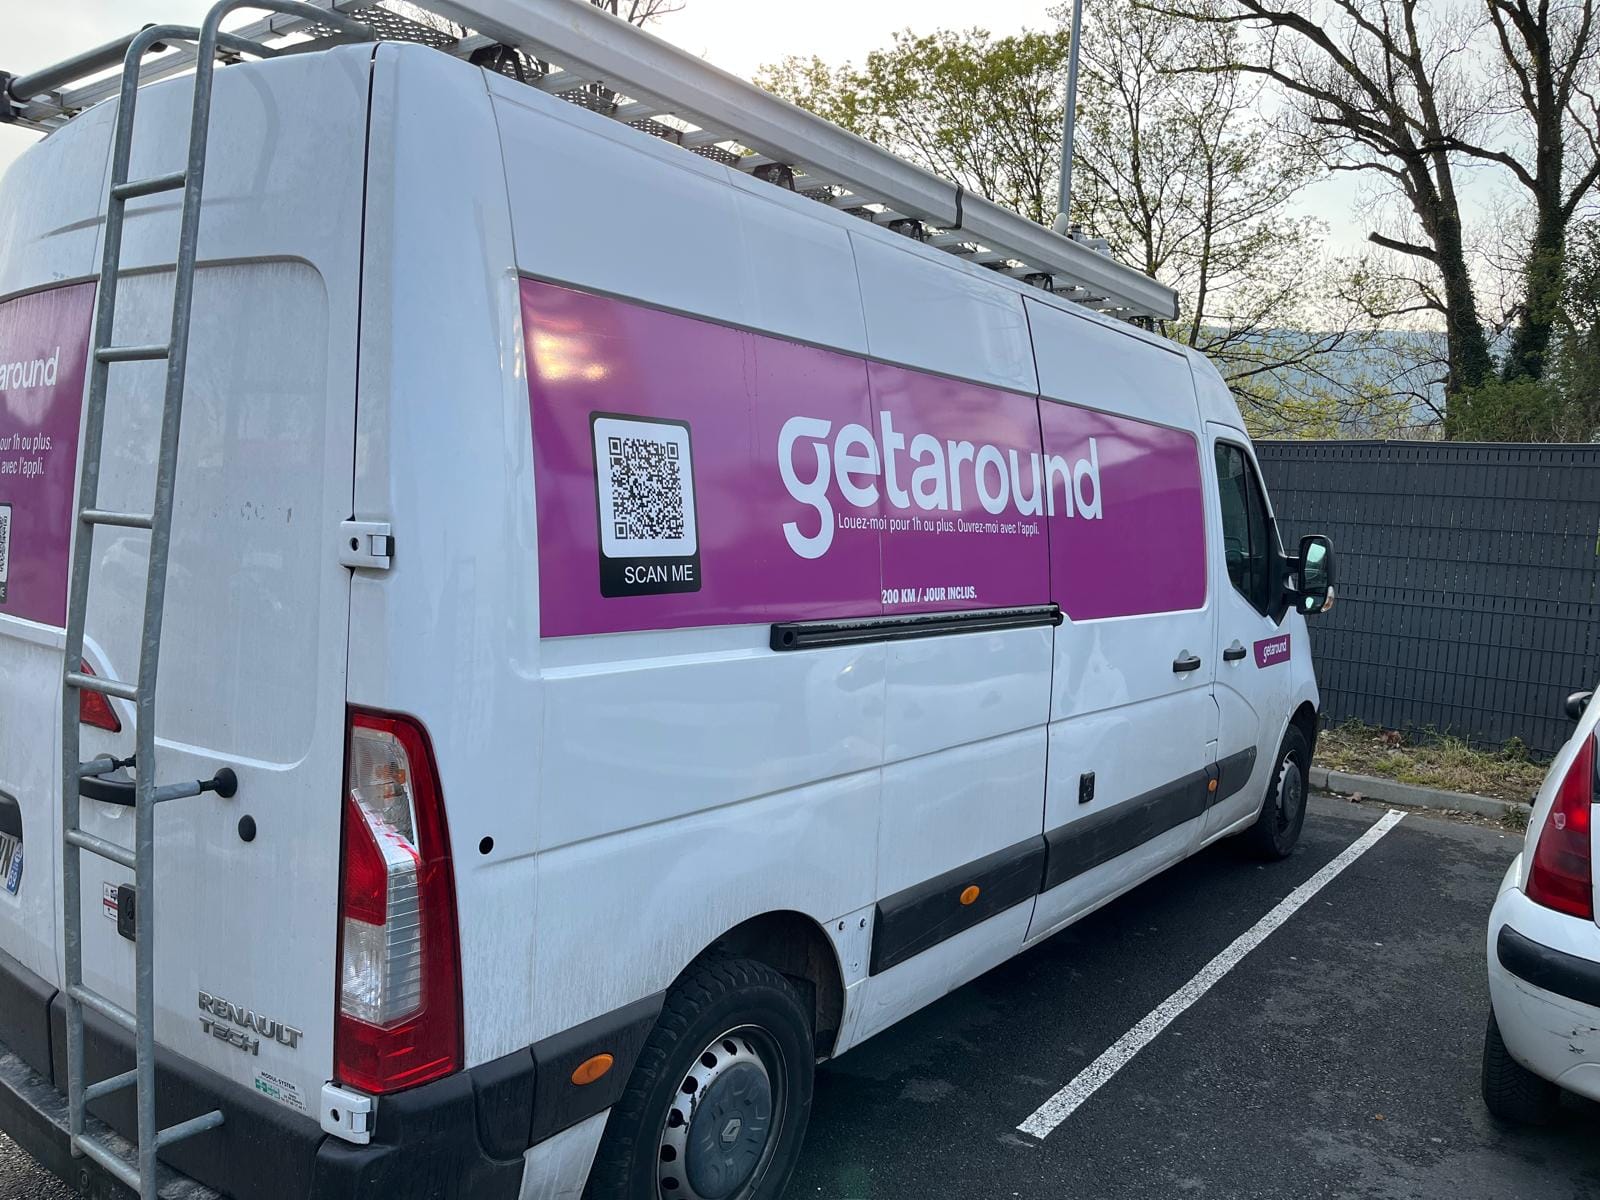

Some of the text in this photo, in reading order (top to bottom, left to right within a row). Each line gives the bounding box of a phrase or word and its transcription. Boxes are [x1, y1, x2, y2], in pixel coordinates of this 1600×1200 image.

[12, 432, 20, 450] 1h
[22, 436, 32, 450] ou
[32, 432, 53, 455] plus.
[1, 456, 45, 479] avec l'appli.
[777, 410, 1103, 559] getaround
[838, 513, 1040, 537] Louez-moi pour 1h ou plus. Ouvrez-moi avec l'appli.
[624, 564, 694, 584] SCAN ME
[881, 585, 978, 604] 200 KM / JOUR INCLUS.
[1263, 637, 1287, 663] getaround
[198, 990, 304, 1049] RENAULT
[199, 1015, 260, 1057] TECH
